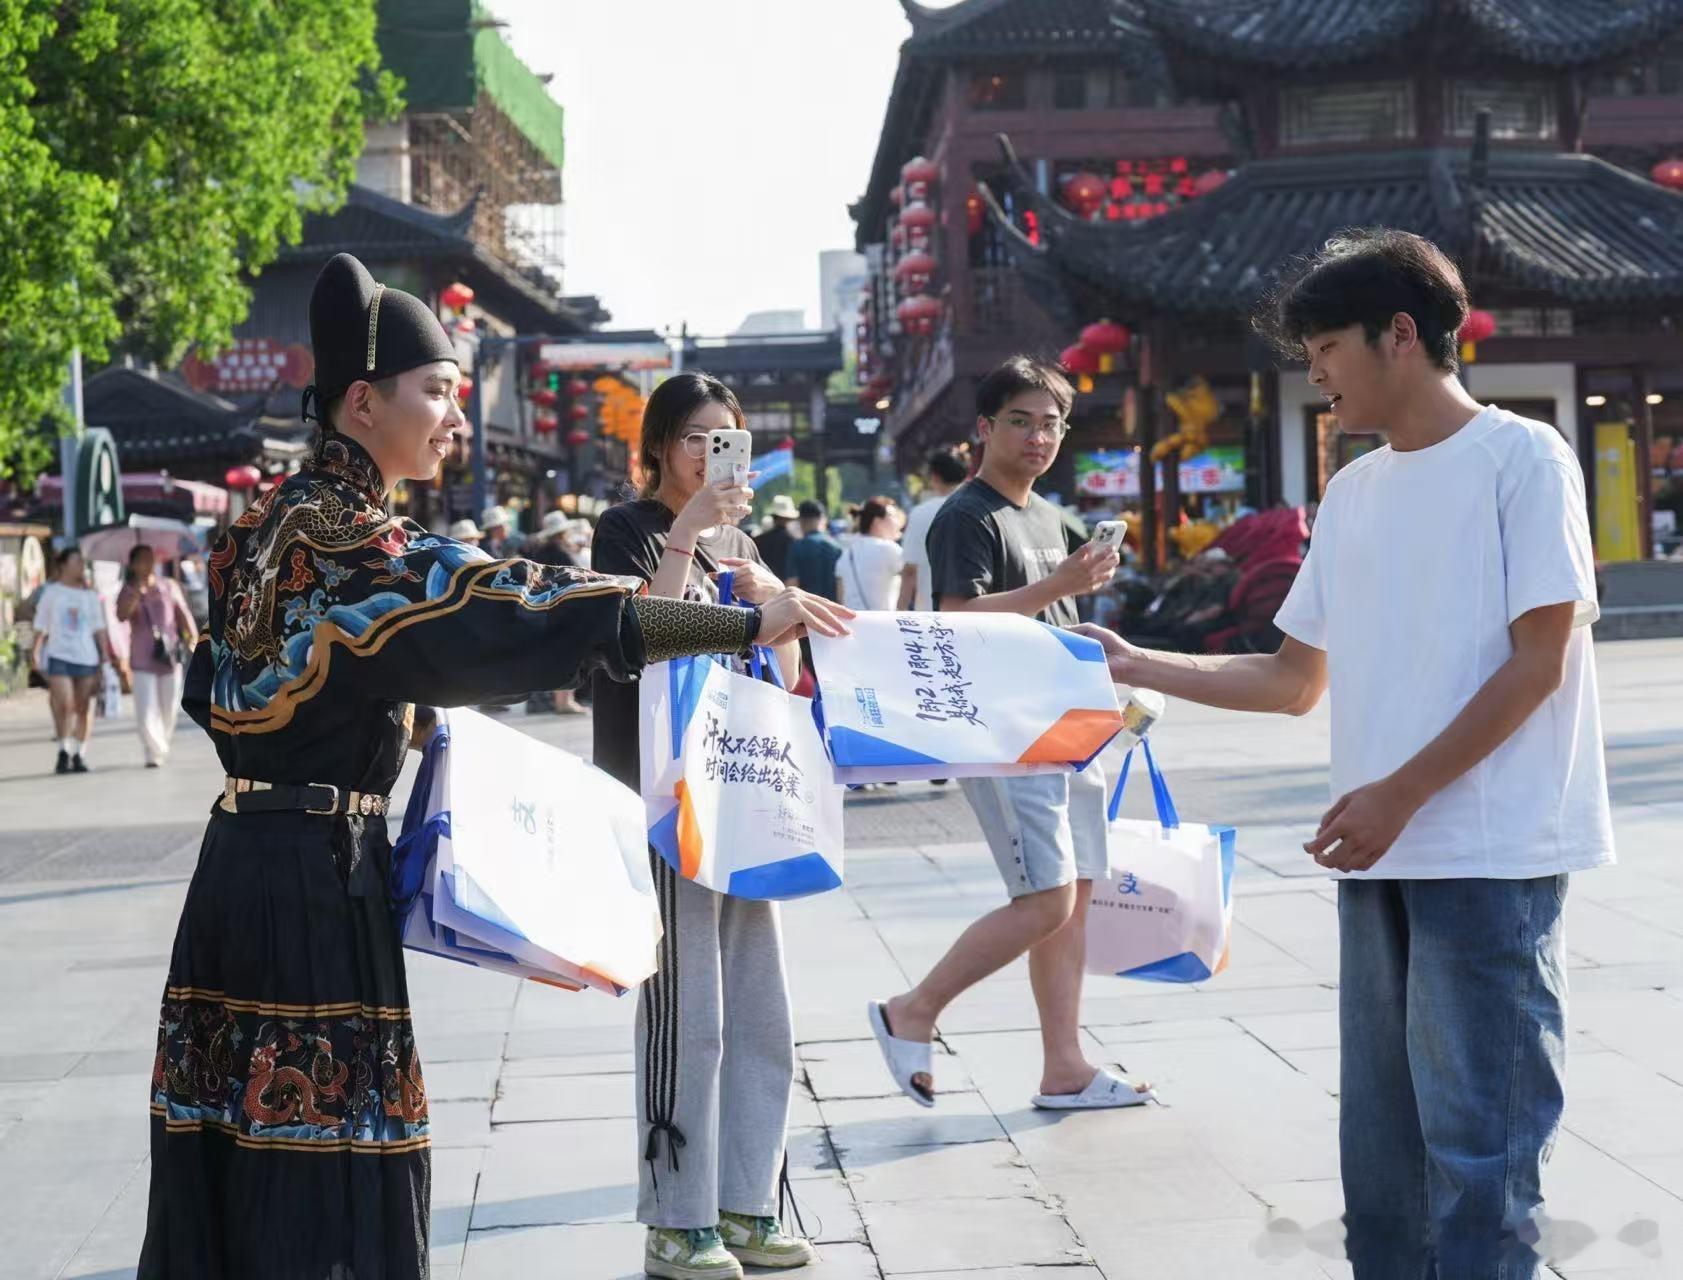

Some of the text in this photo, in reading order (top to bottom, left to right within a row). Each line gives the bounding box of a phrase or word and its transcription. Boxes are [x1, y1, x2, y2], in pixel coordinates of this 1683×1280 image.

[703, 711, 804, 777] 汗水不会骗人
[705, 756, 804, 803] 时间会给出答案
